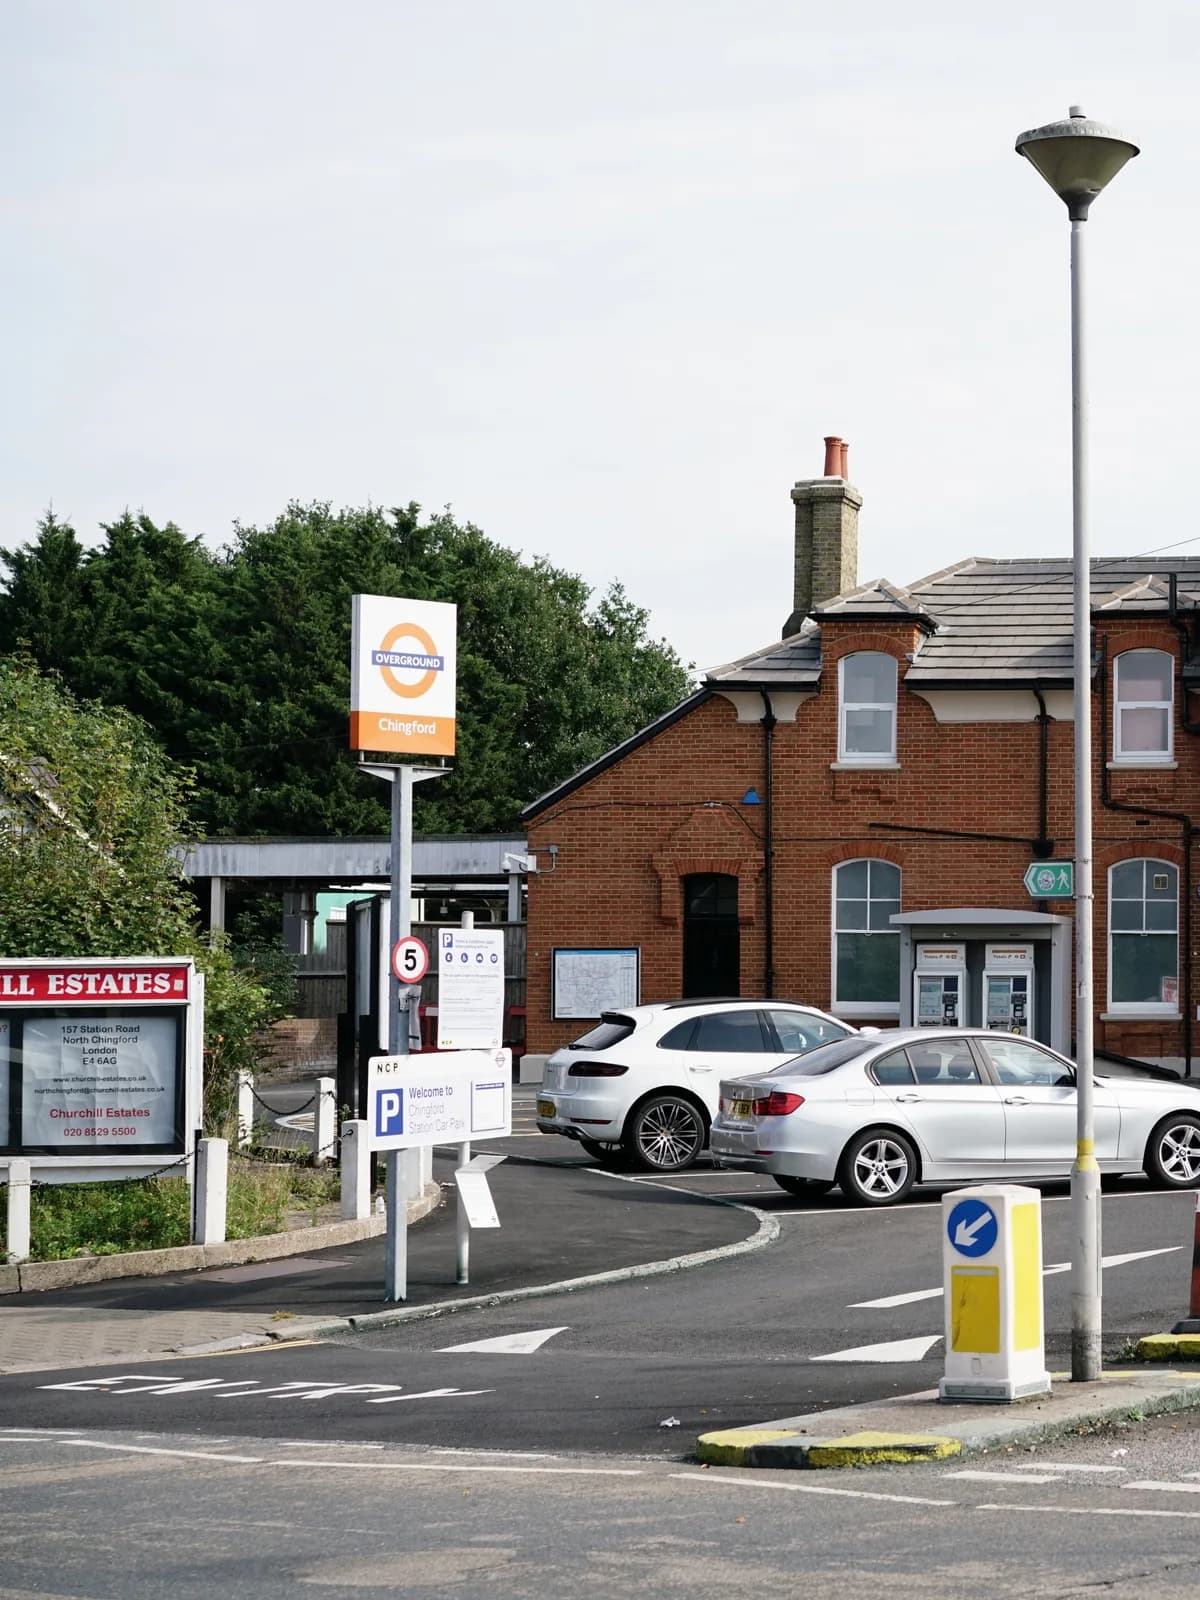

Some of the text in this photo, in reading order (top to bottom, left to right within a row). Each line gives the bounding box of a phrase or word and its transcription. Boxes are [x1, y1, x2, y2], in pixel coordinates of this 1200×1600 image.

[375, 653, 440, 668] OVERGROUND
[378, 718, 436, 736] Chingford
[405, 949, 417, 972] 5
[0, 973, 171, 995] LL ESTATES
[61, 1024, 140, 1034] 157 Station Road
[63, 1035, 138, 1045] North Chingford
[82, 1046, 118, 1055] London
[82, 1056, 118, 1065] E4 6AG
[409, 1084, 454, 1099] Welcome to
[49, 1107, 151, 1118] Churchill Estates
[408, 1102, 445, 1118] Chingford
[63, 1127, 136, 1137] 020 8529 5500
[408, 1120, 433, 1135] Station
[436, 1119, 448, 1131] Car
